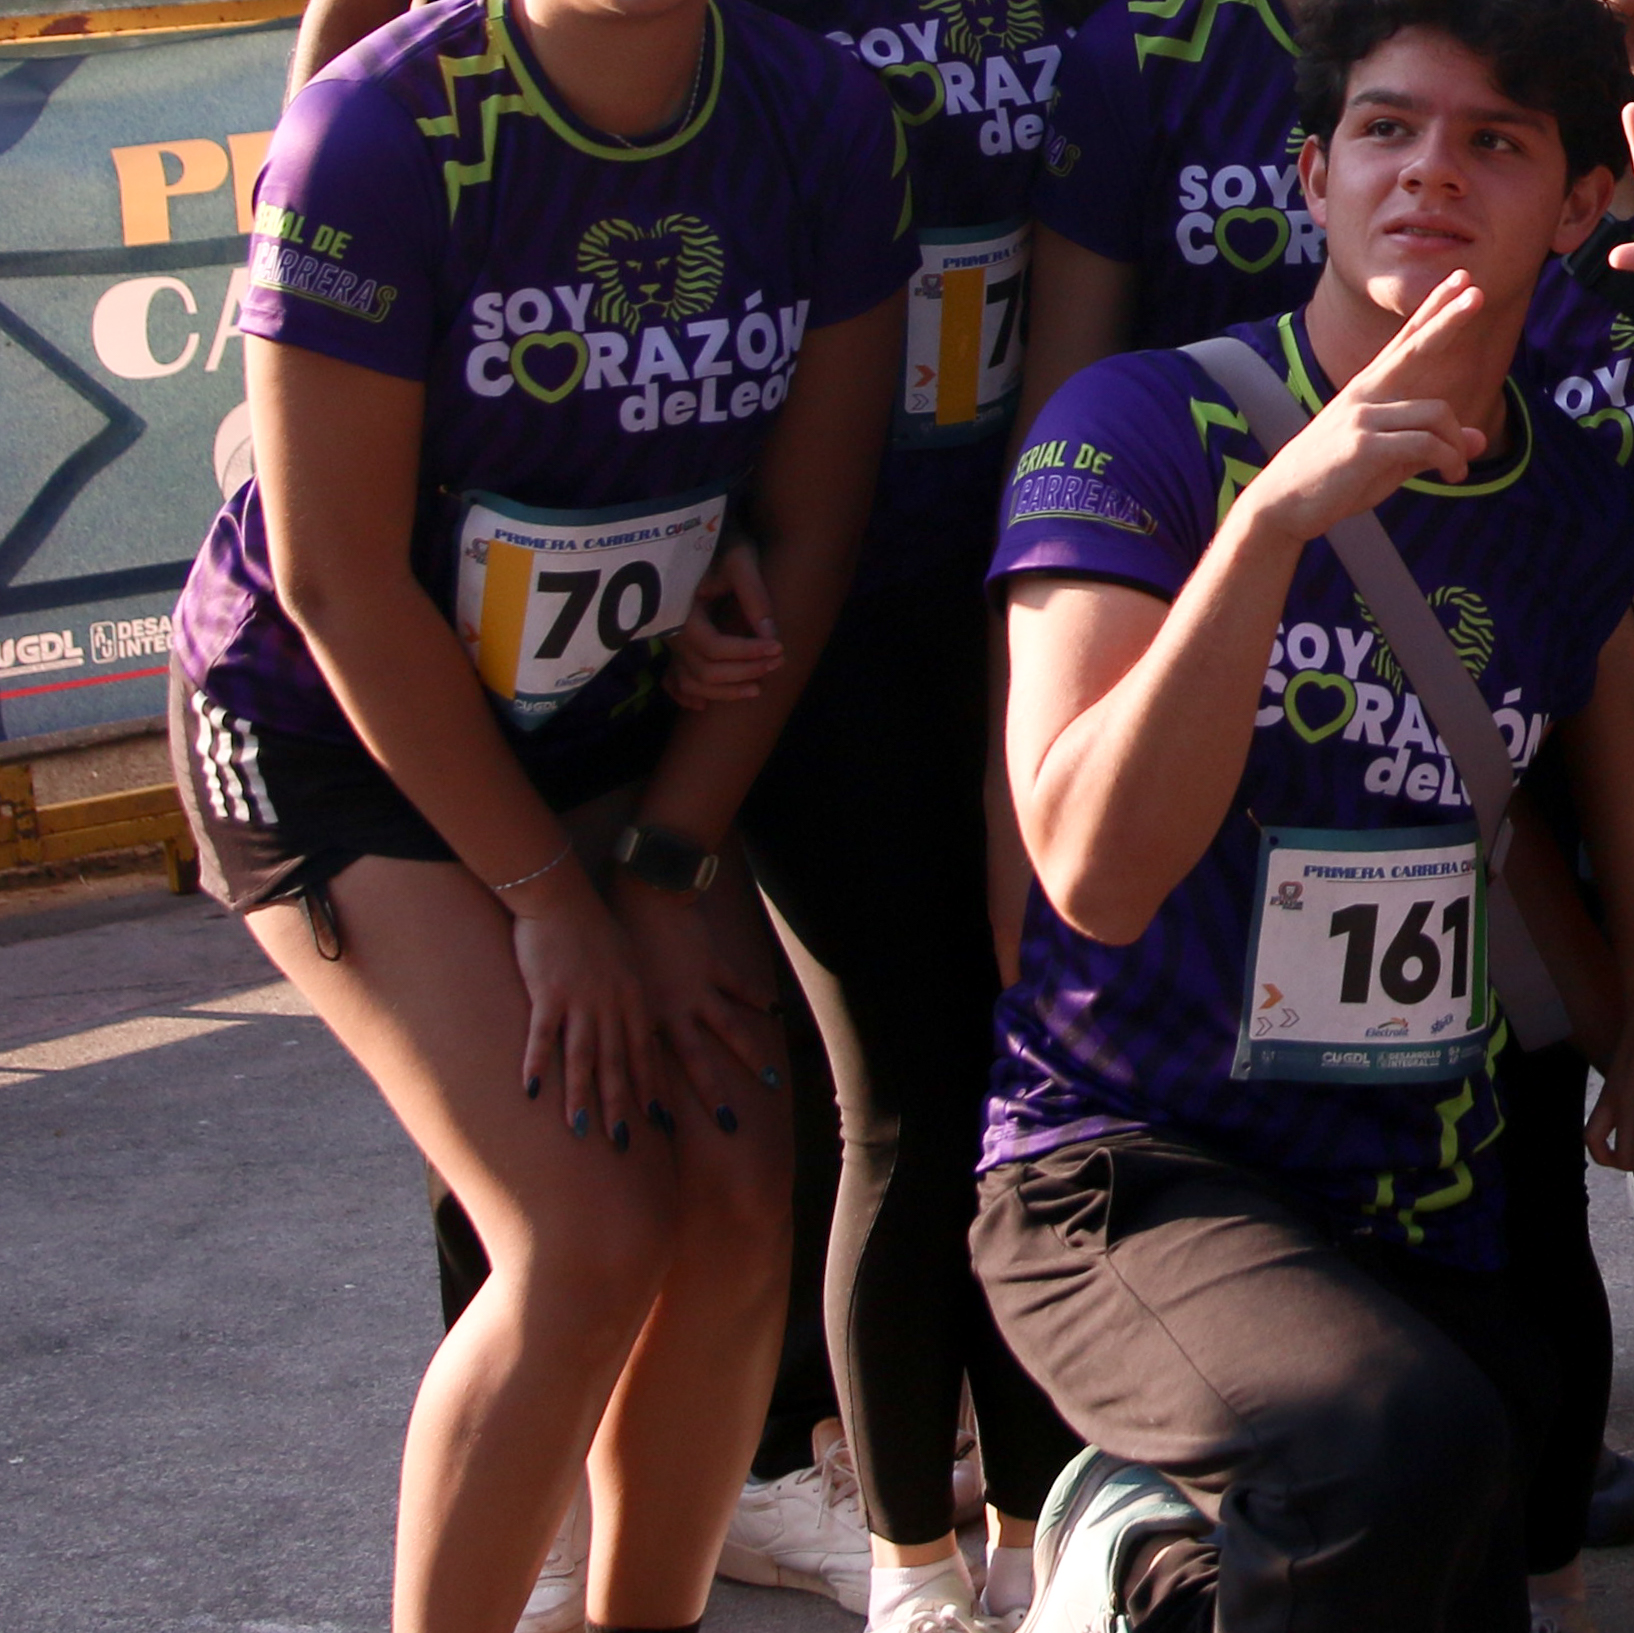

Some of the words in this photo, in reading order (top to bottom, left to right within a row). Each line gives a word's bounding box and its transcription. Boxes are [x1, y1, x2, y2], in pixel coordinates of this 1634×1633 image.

[311, 224, 353, 259] DE
[471, 283, 595, 342] SOY
[1073, 443, 1114, 475] DE
[494, 528, 578, 551] PRIMERA
[583, 528, 661, 550] CARRERA
[534, 559, 662, 659] 70
[1303, 864, 1385, 879] PRIMERA
[1391, 861, 1458, 879] CARRERA
[1329, 894, 1471, 1005] 161
